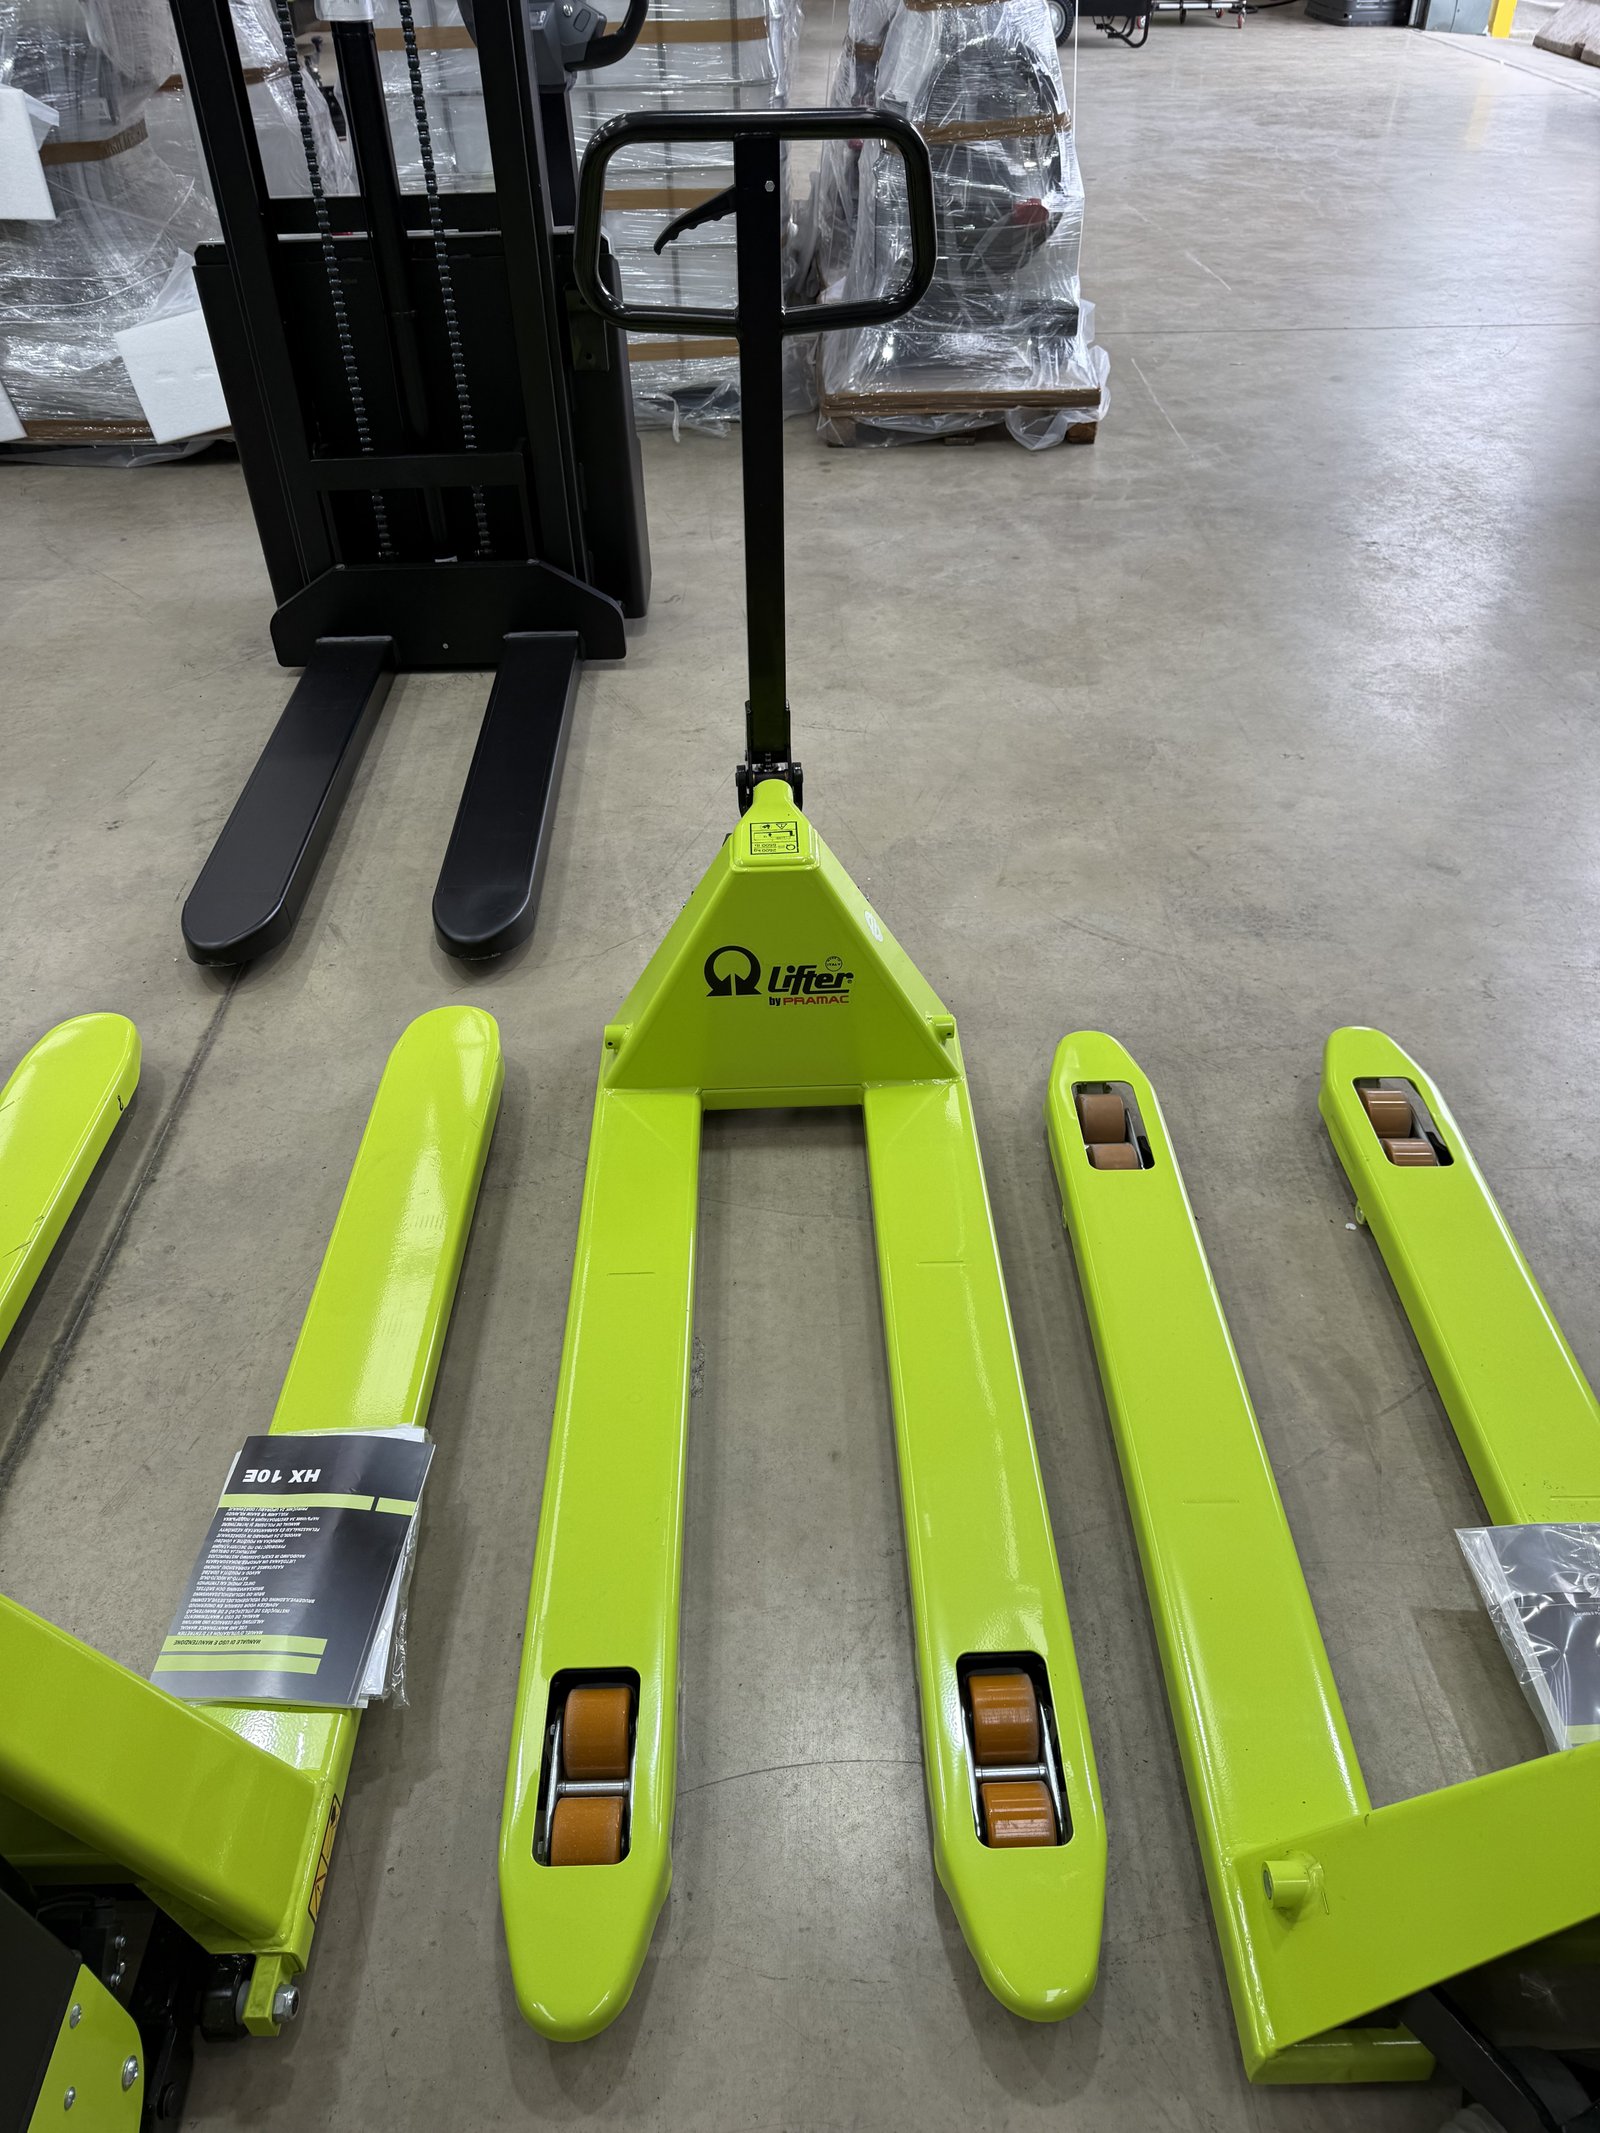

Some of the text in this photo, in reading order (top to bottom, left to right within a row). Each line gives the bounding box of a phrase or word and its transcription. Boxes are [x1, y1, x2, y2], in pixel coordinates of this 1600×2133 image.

[768, 965, 854, 995] Lifter
[769, 995, 849, 1006] by PRAMAC
[242, 1468, 321, 1484] HX 10E
